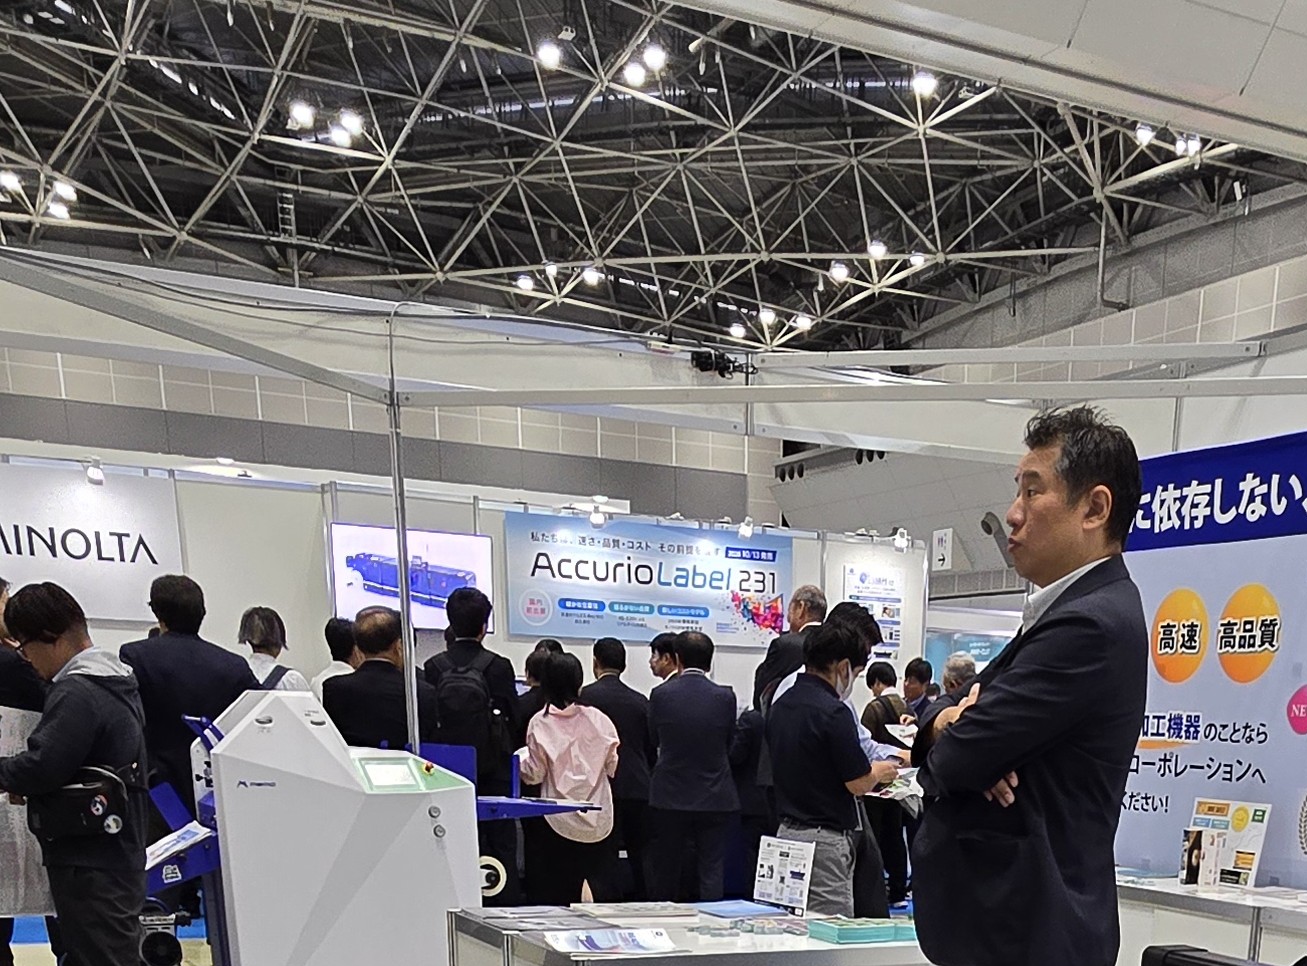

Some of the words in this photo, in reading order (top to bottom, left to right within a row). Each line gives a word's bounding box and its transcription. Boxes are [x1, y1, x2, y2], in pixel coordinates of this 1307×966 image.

[531, 552, 732, 591] AccurioLabel
[739, 570, 777, 594] 231
[1159, 621, 1199, 651] 高速
[1219, 618, 1278, 650] 高品質
